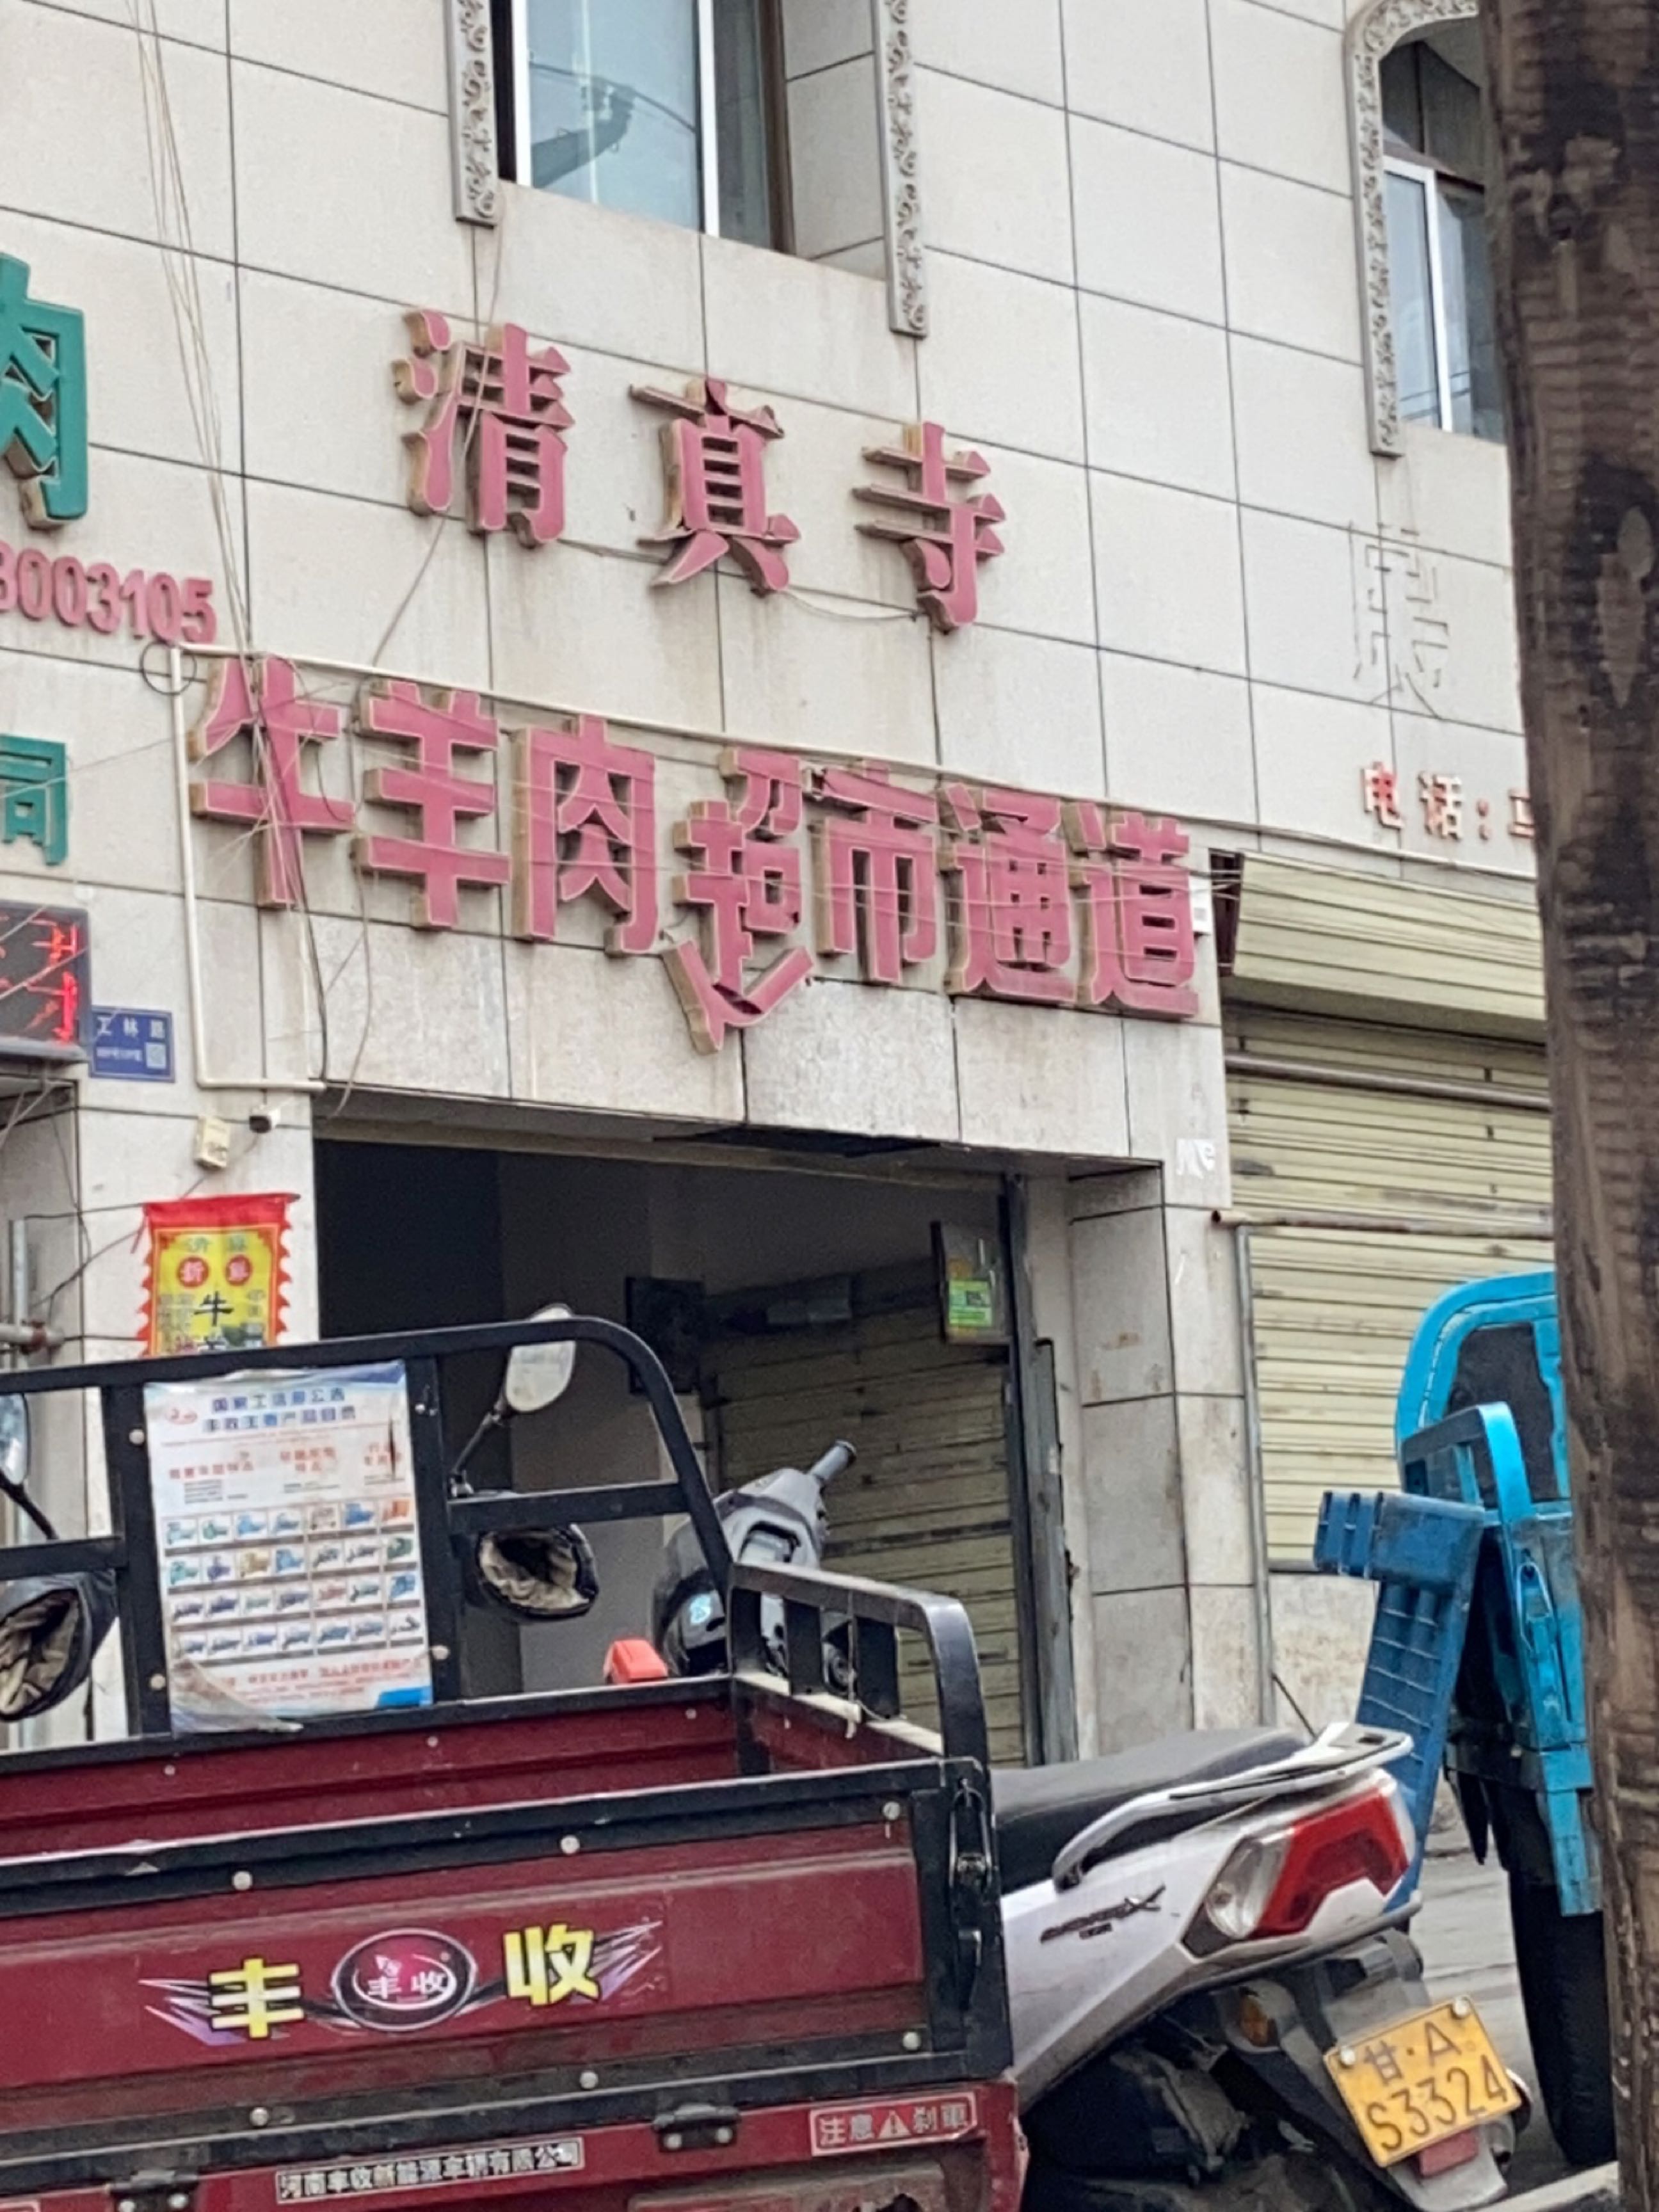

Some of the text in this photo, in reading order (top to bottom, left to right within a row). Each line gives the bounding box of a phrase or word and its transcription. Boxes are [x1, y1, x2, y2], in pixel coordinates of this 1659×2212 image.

[393, 309, 1005, 634] 清真寺
[188, 656, 1201, 1055] 牛羊肉超市通道
[209, 1923, 602, 2038] 丰 收
[819, 2113, 876, 2146] 注意
[1366, 2054, 1508, 2150] S3324
